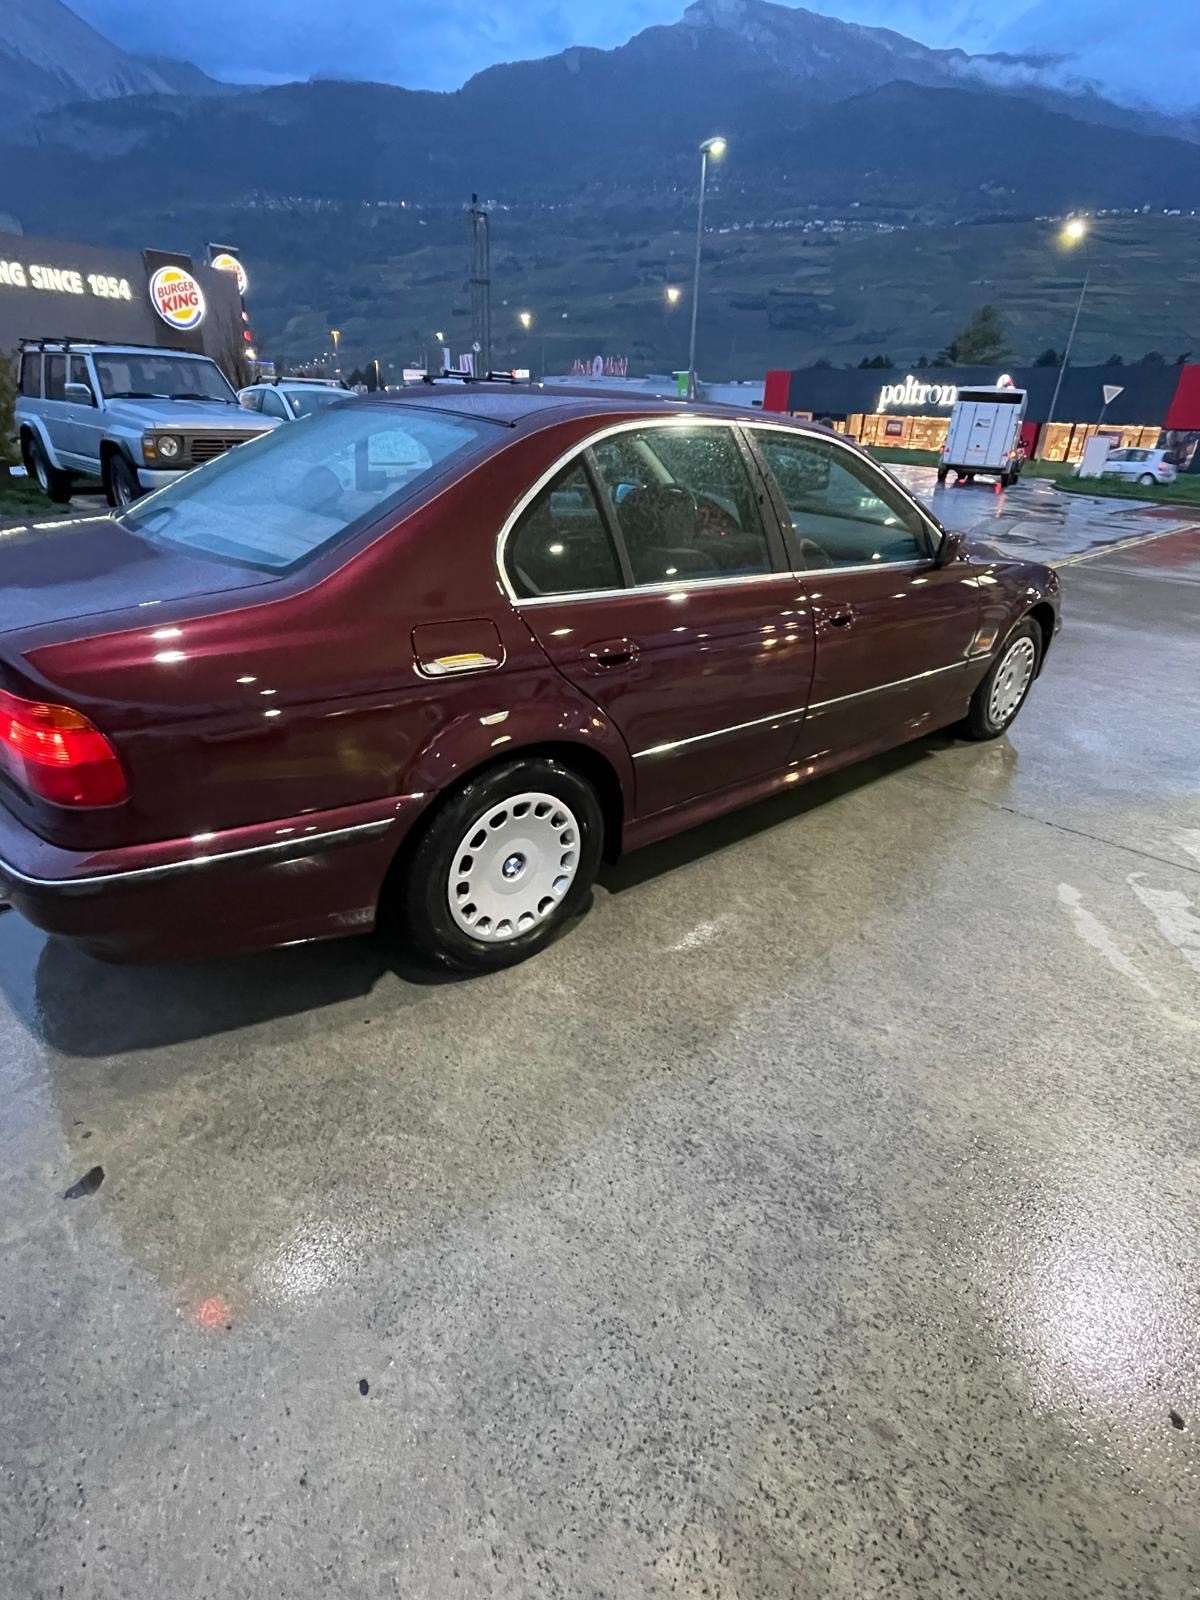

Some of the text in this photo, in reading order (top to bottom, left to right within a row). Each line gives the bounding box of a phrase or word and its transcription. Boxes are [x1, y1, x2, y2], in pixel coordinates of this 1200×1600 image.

[29, 264, 84, 294] SINCE
[87, 273, 132, 301] 1954
[157, 281, 195, 299] BURGER
[161, 291, 199, 314] KING
